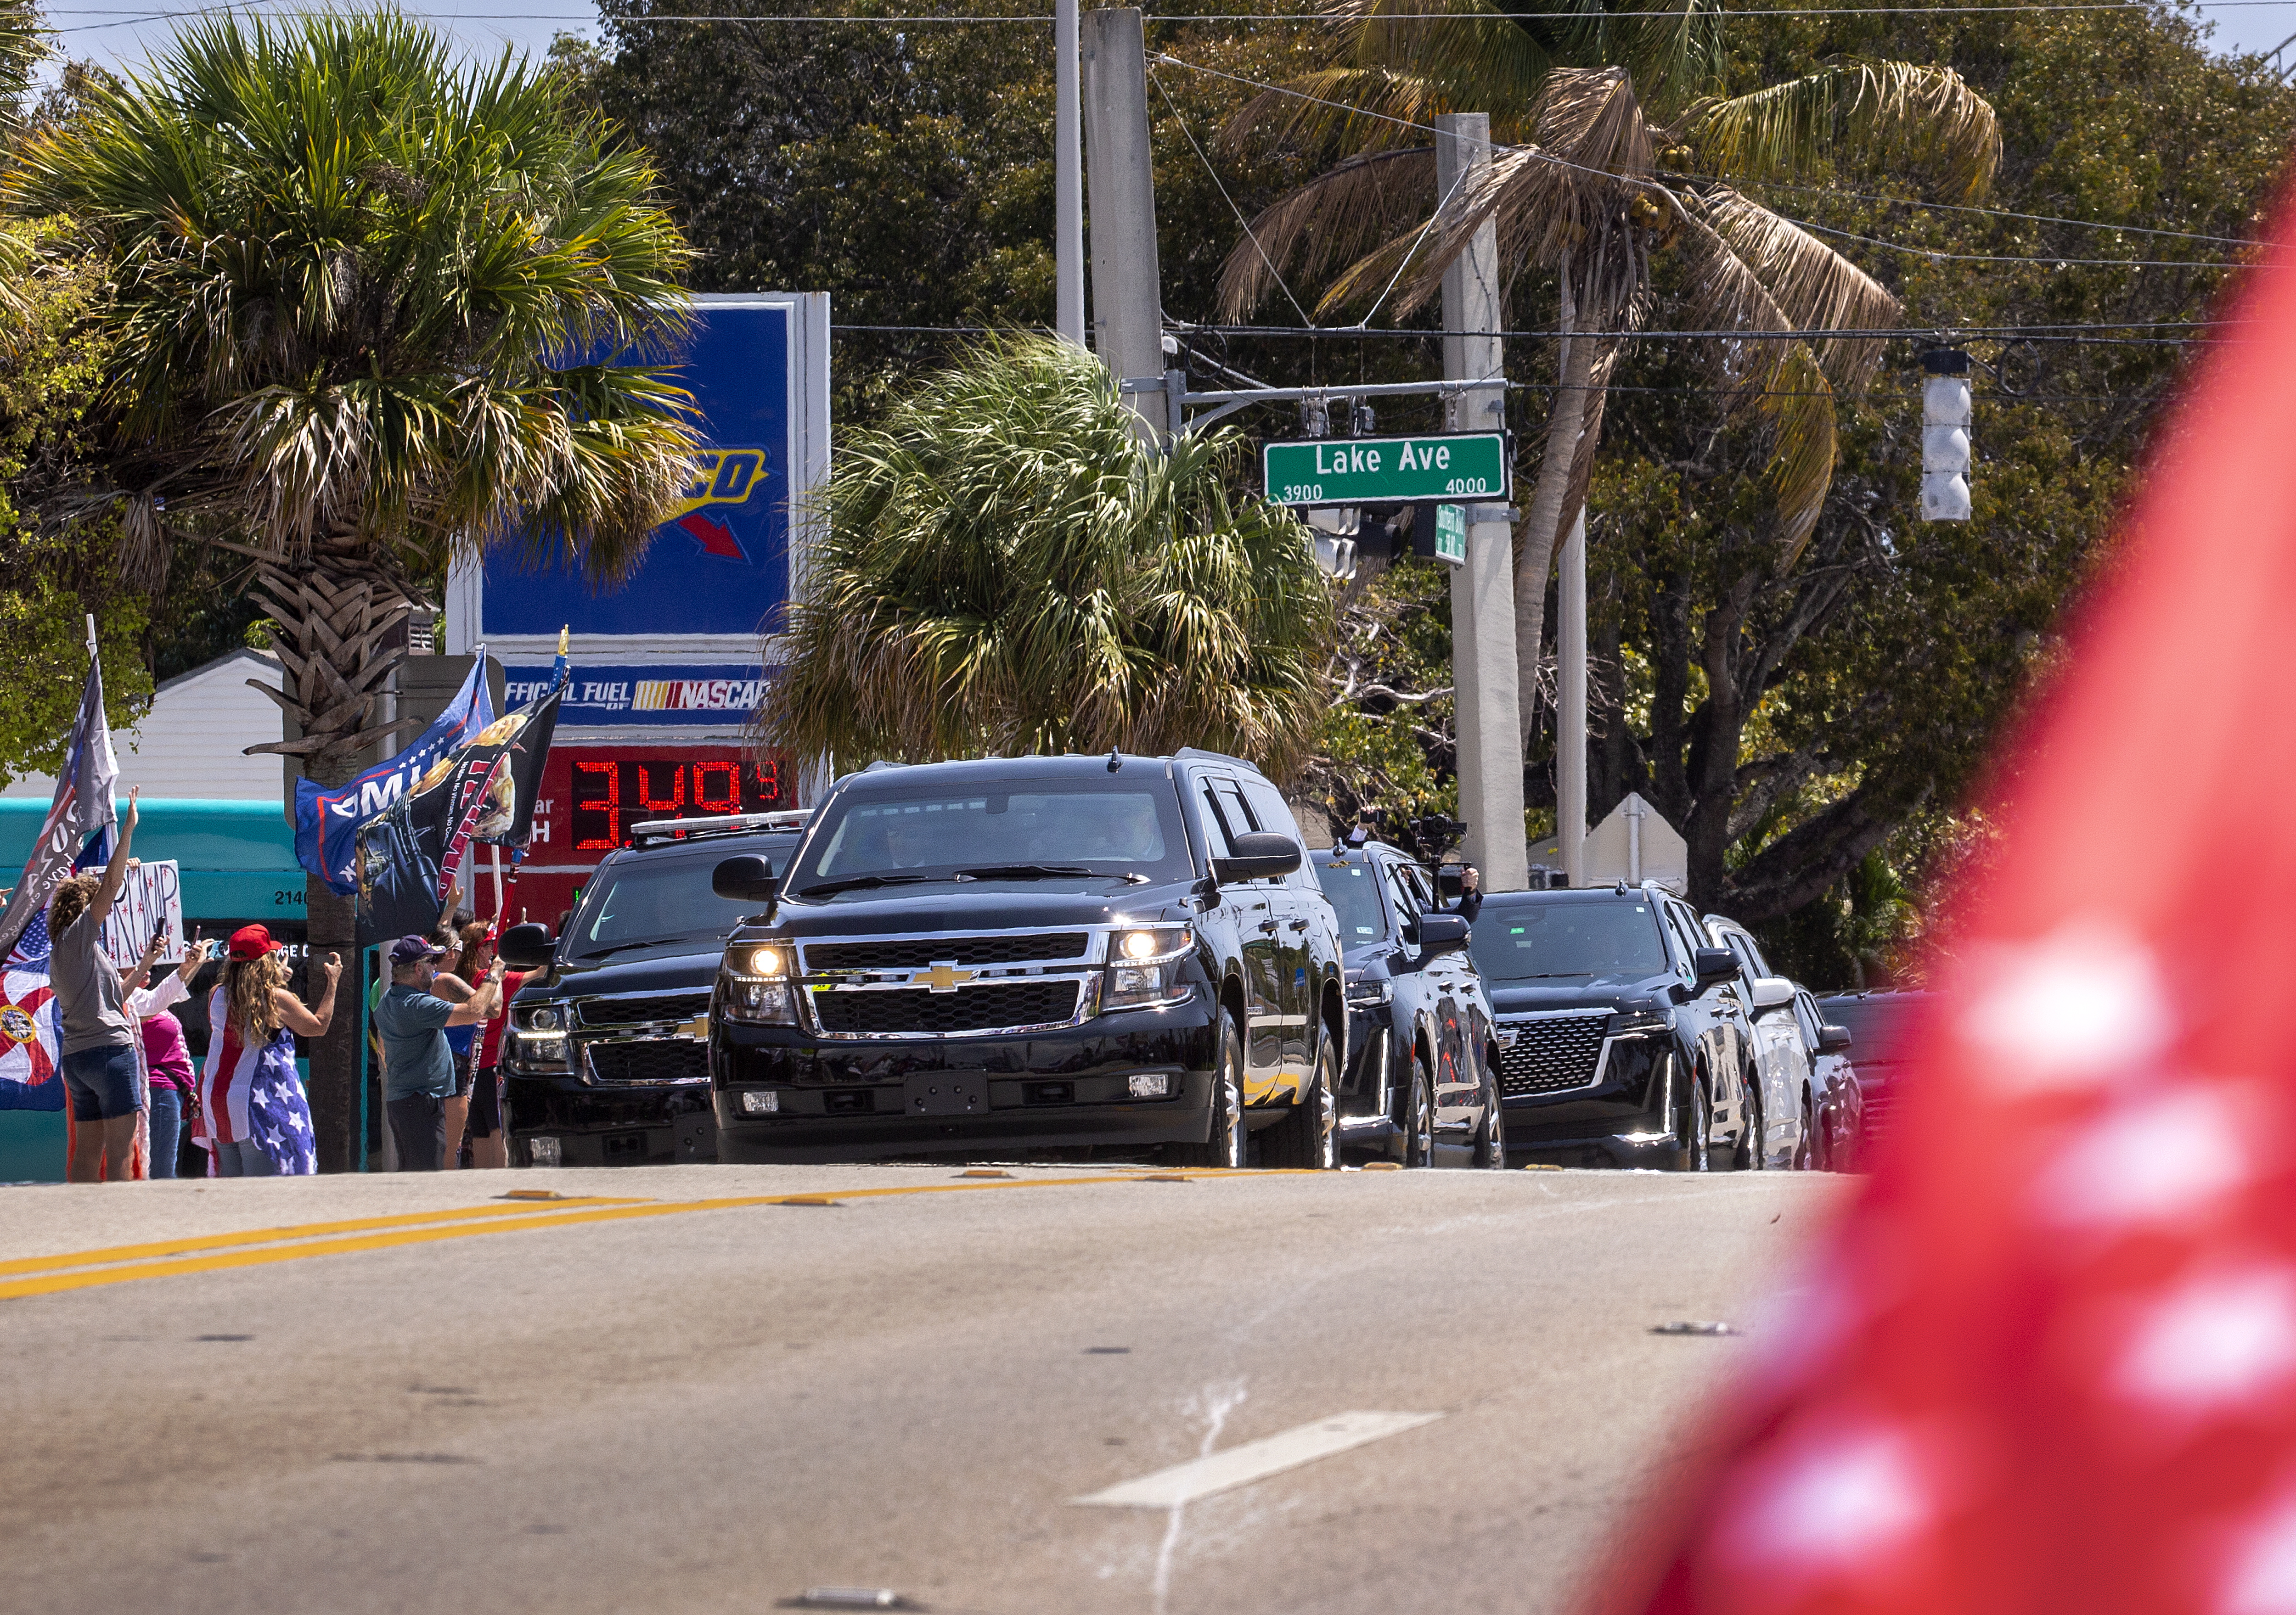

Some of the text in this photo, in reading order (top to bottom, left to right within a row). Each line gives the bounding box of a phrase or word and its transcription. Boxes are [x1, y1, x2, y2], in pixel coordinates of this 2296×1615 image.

[1316, 442, 1450, 474] Lake Ave
[1283, 478, 1486, 501] 3900 4000
[581, 682, 630, 701] FUEL
[461, 761, 469, 769] No
[452, 783, 461, 792] No
[447, 791, 458, 817] Woman,
[446, 816, 454, 826] No
